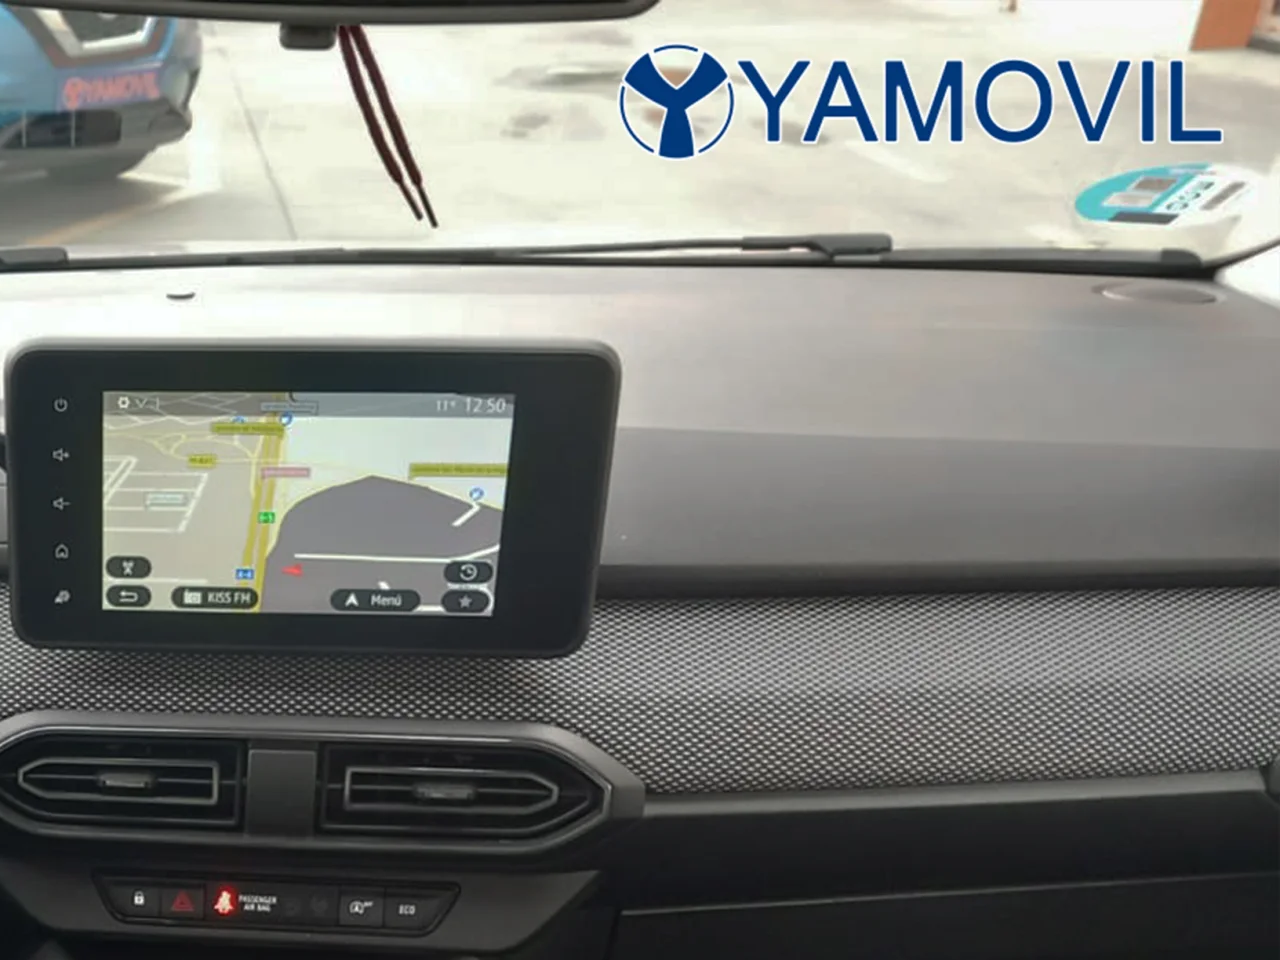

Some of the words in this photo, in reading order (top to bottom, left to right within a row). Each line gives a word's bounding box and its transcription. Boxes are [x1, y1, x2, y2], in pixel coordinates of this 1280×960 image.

[207, 591, 231, 604] KISS
[233, 592, 251, 604] FM
[370, 593, 402, 607] Menú
[399, 904, 416, 915] ECO
